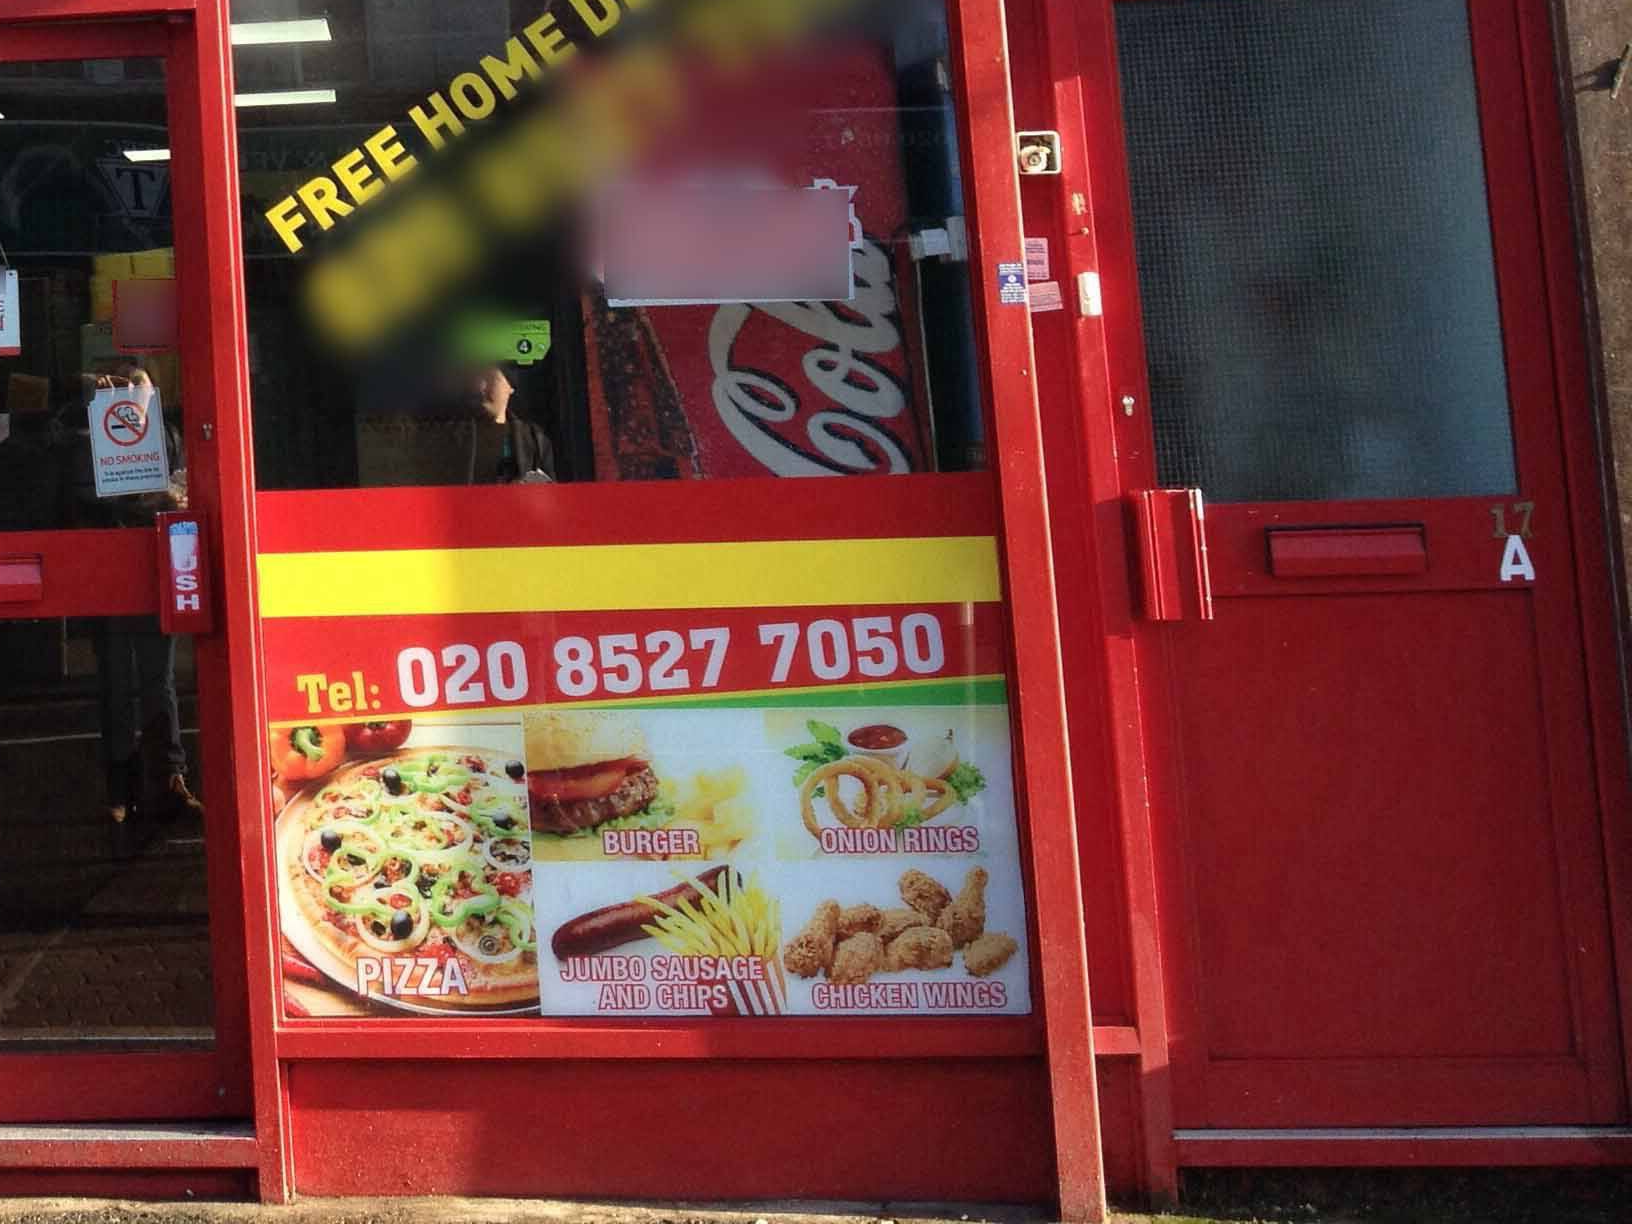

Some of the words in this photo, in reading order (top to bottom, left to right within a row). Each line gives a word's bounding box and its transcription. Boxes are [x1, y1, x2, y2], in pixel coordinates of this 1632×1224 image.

[265, 124, 417, 253] FREE
[407, 13, 578, 151] HOME
[1489, 501, 1535, 539] 17
[1500, 534, 1536, 582] A
[297, 672, 382, 714] Tel:
[396, 640, 528, 708] 020
[552, 627, 731, 698] 8527
[759, 612, 946, 684] 7050
[602, 828, 700, 856] BURGER
[820, 828, 896, 854] ONION
[901, 826, 980, 853] RINGS
[355, 956, 468, 997] PIZZA
[560, 956, 646, 983] JUMBO
[649, 954, 765, 981] SAUSAGE
[598, 984, 652, 1011] AND
[654, 982, 730, 1010] CHIPS
[810, 983, 922, 1010] CHICKEN
[925, 981, 1009, 1008] WINGS
